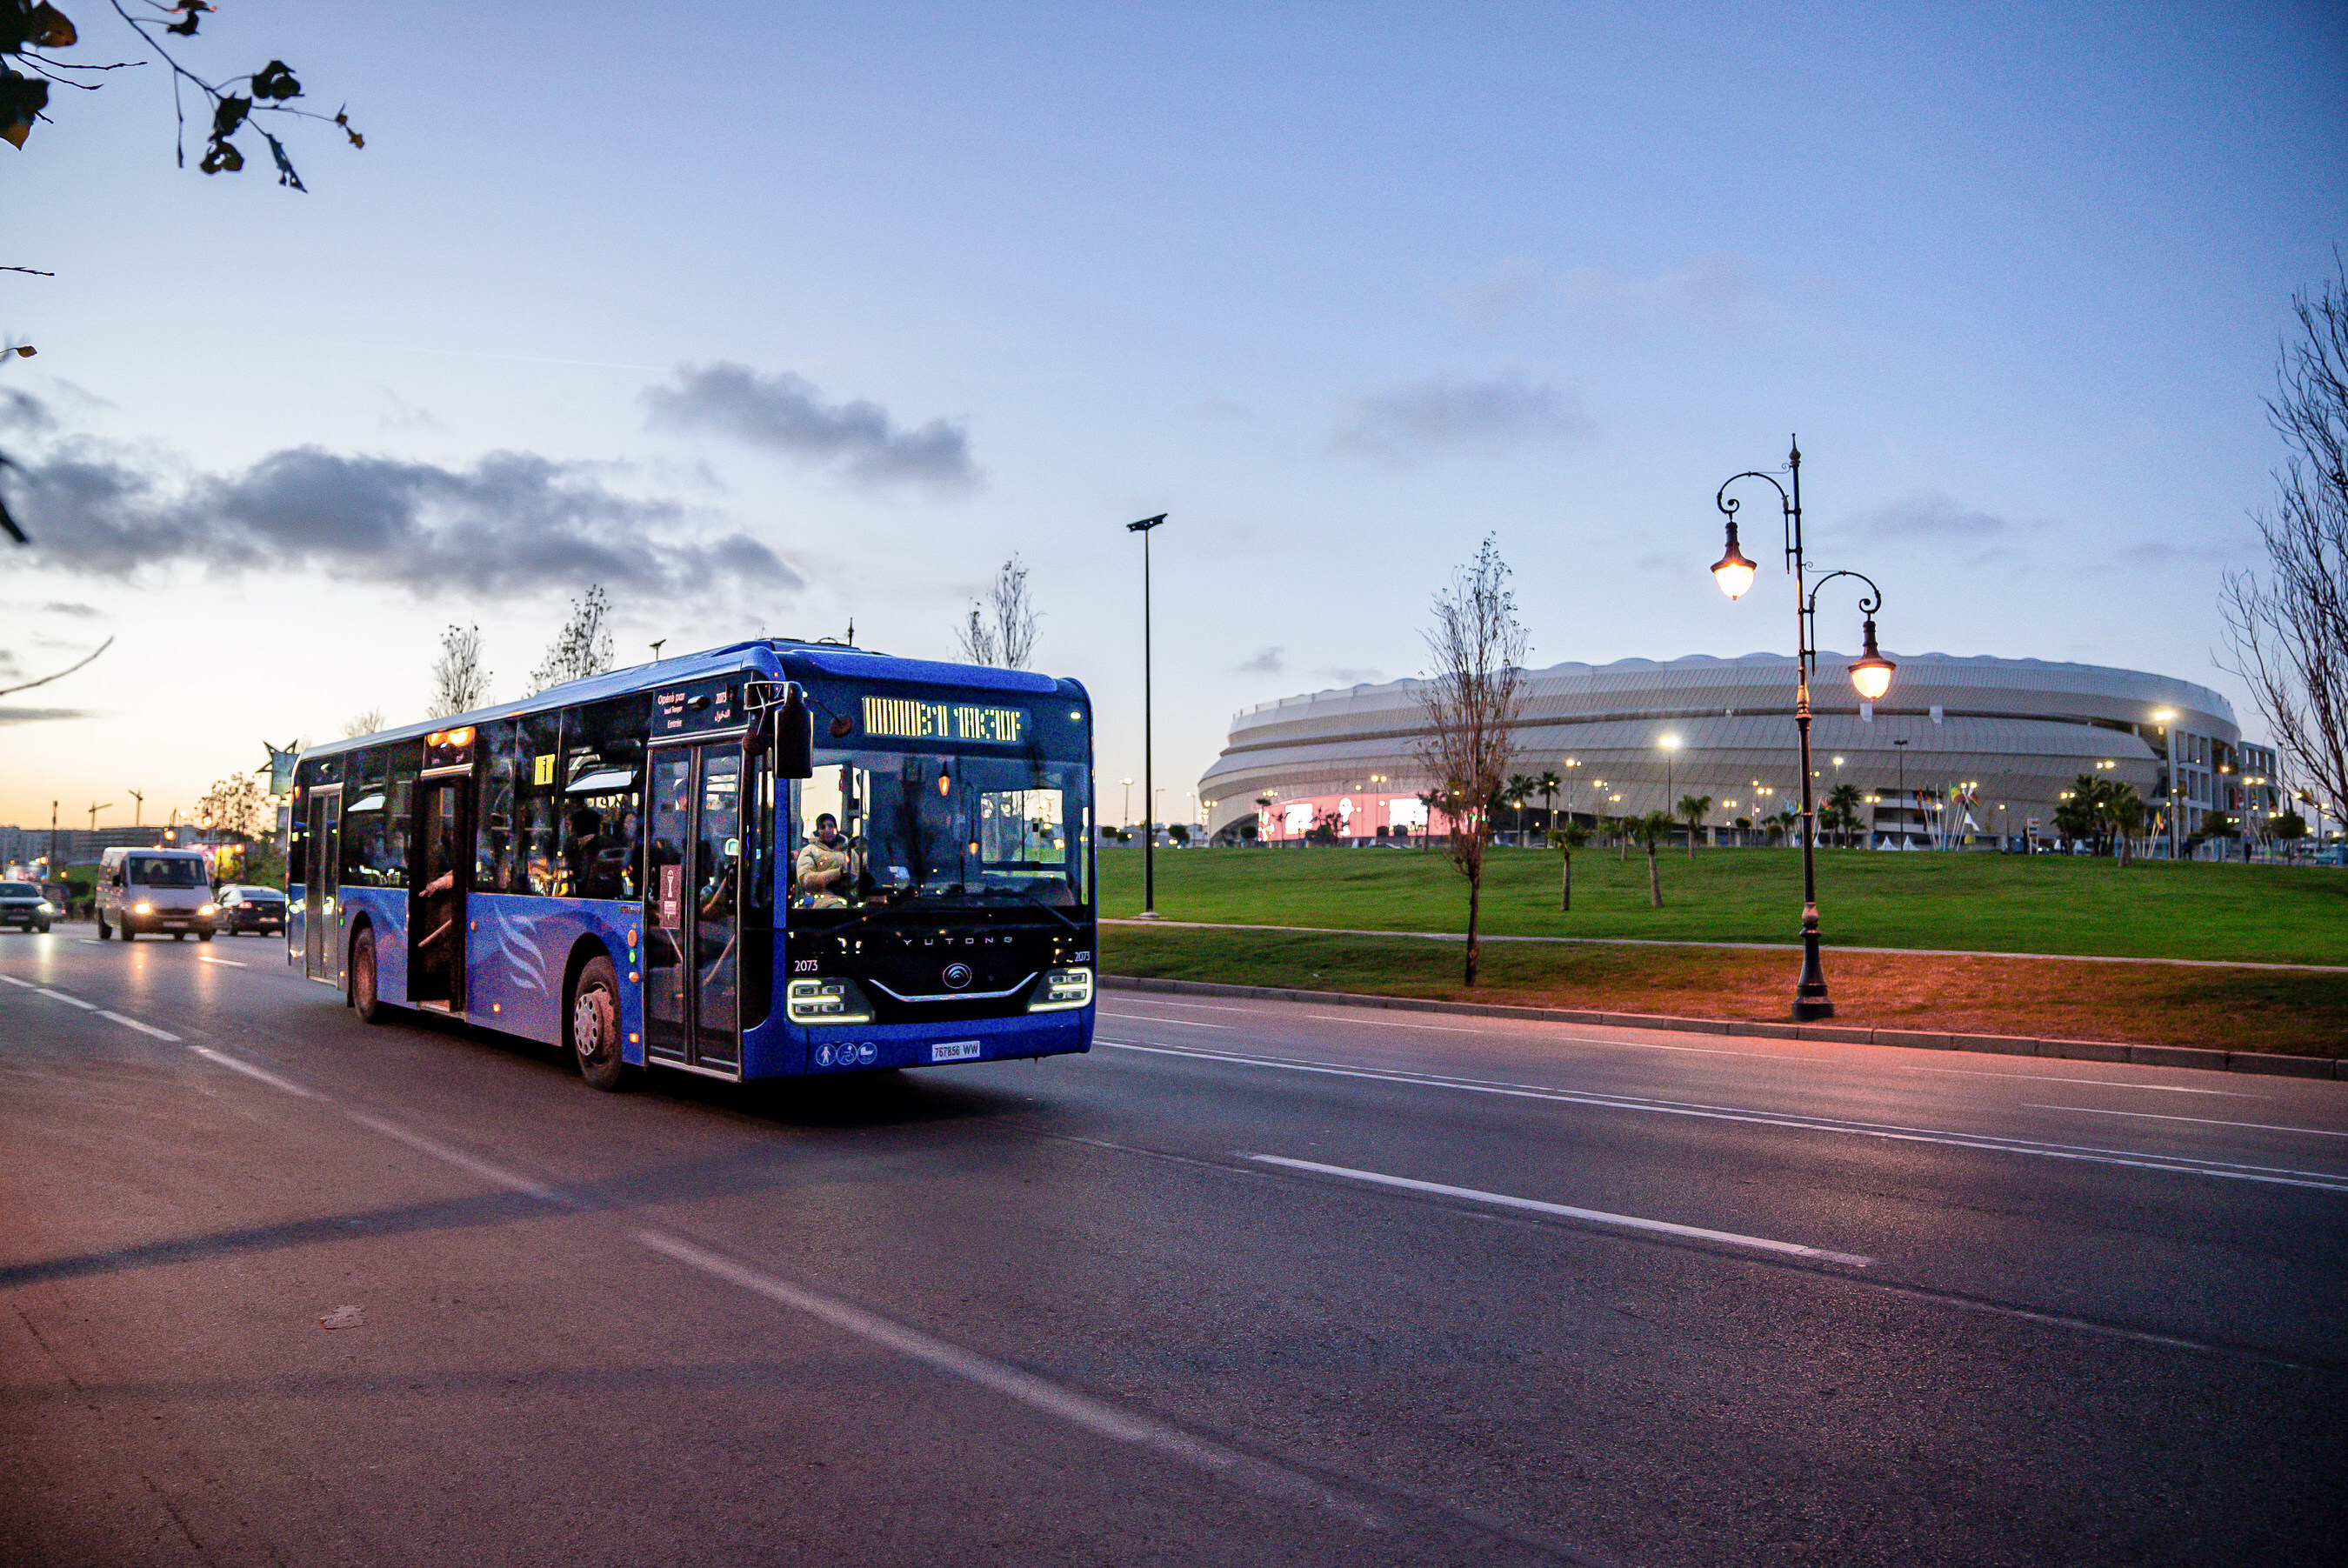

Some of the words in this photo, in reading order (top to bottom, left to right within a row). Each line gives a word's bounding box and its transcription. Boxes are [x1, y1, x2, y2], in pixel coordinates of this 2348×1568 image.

[675, 692, 685, 704] par
[904, 937, 1012, 945] YUTONG
[1074, 951, 1091, 962] 2073
[794, 959, 818, 972] 2073
[935, 1044, 960, 1058] 767856
[963, 1042, 978, 1055] WW
